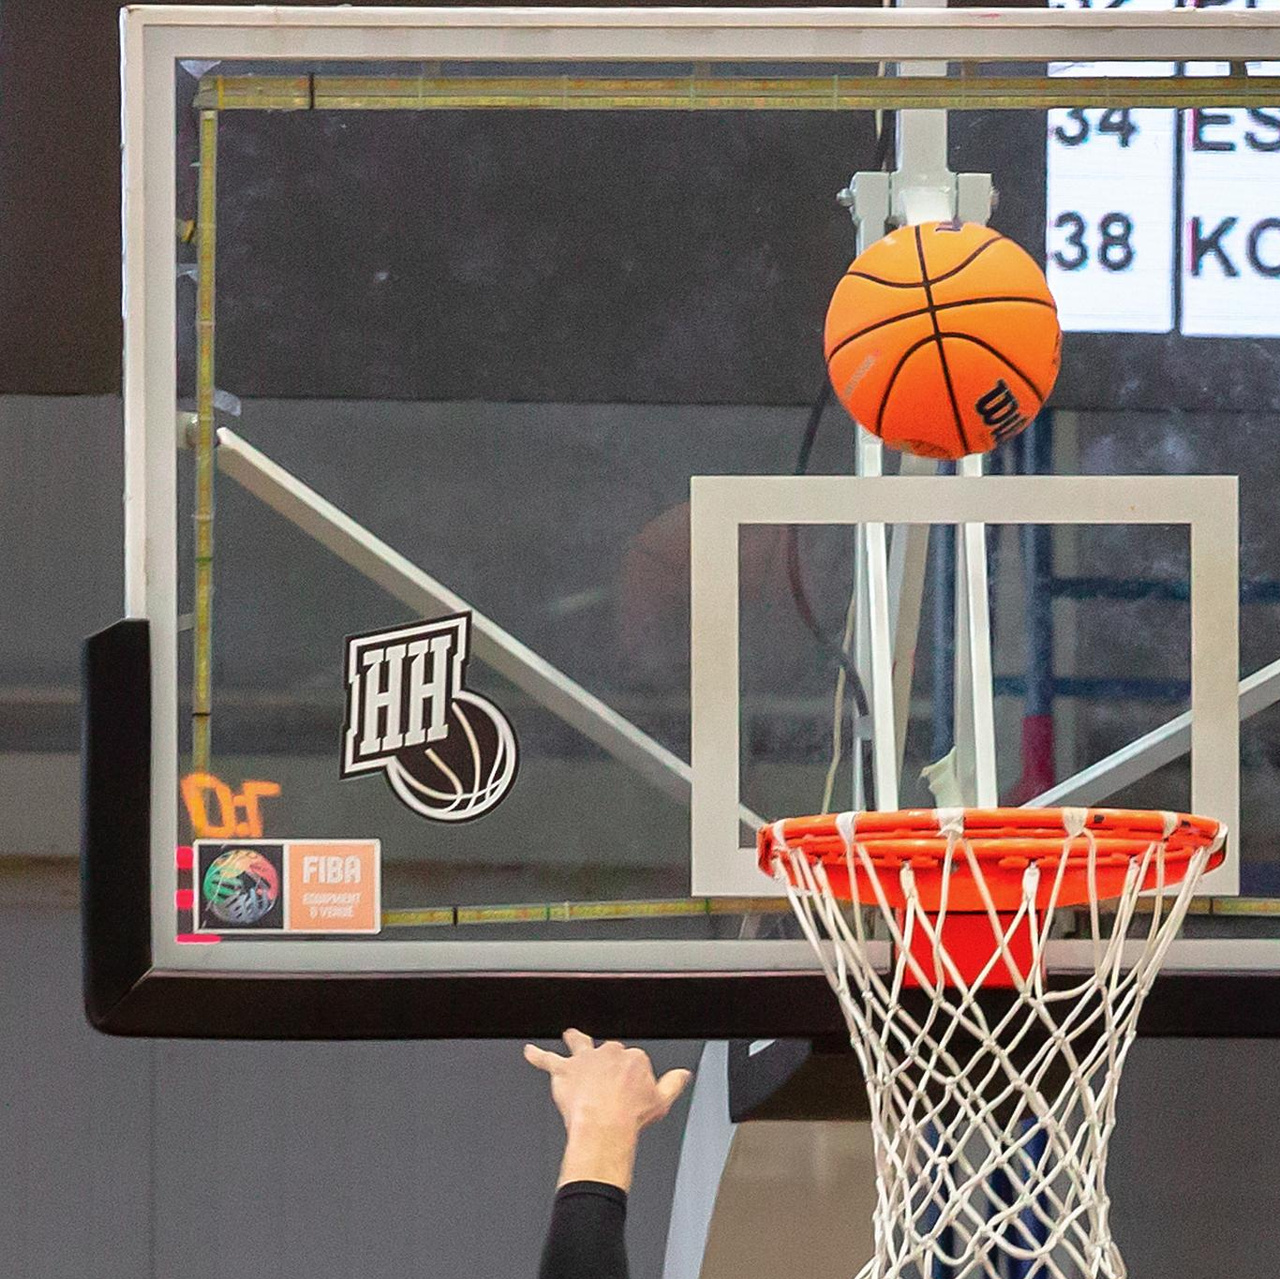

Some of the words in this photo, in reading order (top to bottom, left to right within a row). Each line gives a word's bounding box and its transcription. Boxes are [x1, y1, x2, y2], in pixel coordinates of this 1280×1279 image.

[1053, 107, 1138, 148] 34
[1052, 210, 1136, 272] 38
[302, 855, 362, 884] FIBA
